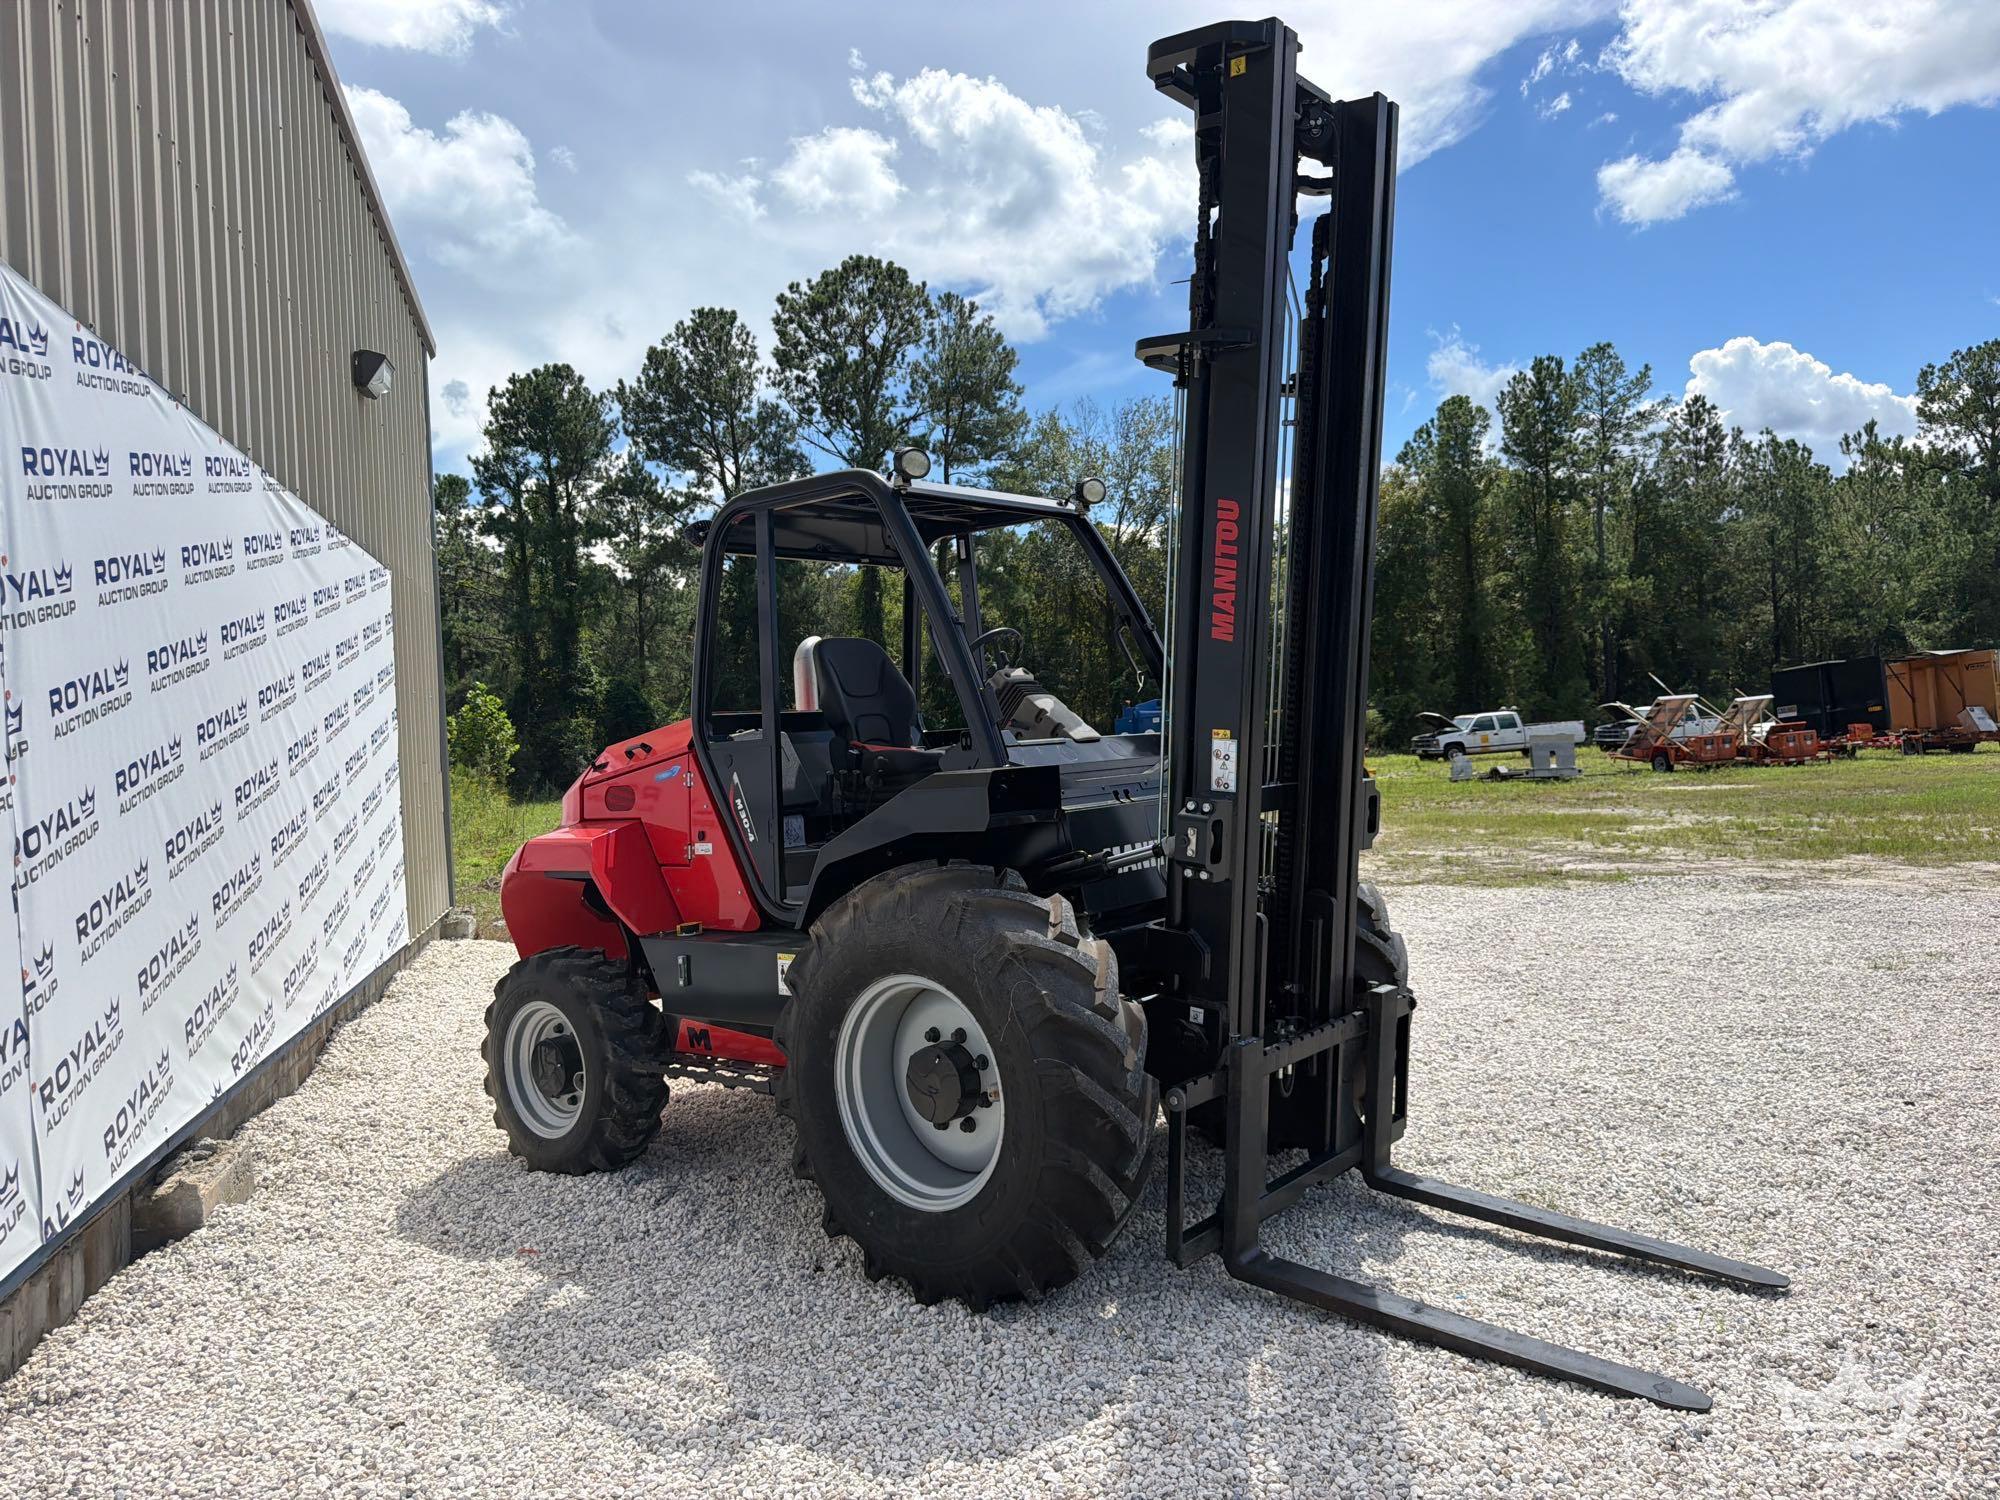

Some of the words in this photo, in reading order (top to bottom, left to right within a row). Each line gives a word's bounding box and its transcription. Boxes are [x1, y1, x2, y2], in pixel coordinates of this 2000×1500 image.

[9, 358, 51, 381] GROUP
[77, 372, 119, 393] AUCTION
[121, 380, 150, 397] GROUP
[21, 447, 94, 476] ROYAL
[130, 452, 181, 477] ROYAL
[205, 456, 242, 477] ROYAL
[27, 484, 77, 500] AUCTION
[78, 483, 112, 499] GROUP
[133, 483, 168, 497] AUCTION
[170, 483, 194, 495] GROUP
[208, 483, 234, 494] AUCTION
[234, 482, 252, 492] GROUP
[181, 542, 224, 568] ROYAL
[244, 533, 276, 556] ROYAL
[290, 527, 315, 546] ROYAL
[94, 553, 152, 586] ROYAL
[184, 569, 213, 586] AUCTION
[215, 564, 236, 578] GROUP
[247, 557, 268, 571] AUCTION
[267, 554, 284, 566] GROUP
[1211, 499, 1240, 642] MANITOU
[98, 586, 138, 607] AUCTION
[140, 579, 168, 597] GROUP
[313, 585, 335, 607] ROYAL
[344, 576, 362, 594] ROYAL
[2, 611, 36, 630] TION
[38, 600, 76, 623] GROUP
[274, 598, 301, 624] ROYAL
[220, 615, 257, 645] ROYAL
[223, 642, 249, 661] AUCTION
[249, 633, 267, 651] GROUP
[336, 637, 355, 659] ROYAL
[362, 623, 378, 641] ROYAL
[147, 637, 197, 675] ROYAL
[302, 655, 325, 680] ROYAL
[49, 668, 115, 718] ROYAL
[151, 669, 185, 694] AUCTION
[186, 658, 211, 678] GROUP
[258, 680, 289, 708] ROYAL
[260, 707, 282, 724] AUCTION
[281, 692, 297, 710] GROUP
[353, 685, 369, 707] ROYAL
[54, 705, 99, 740] AUCTION
[100, 691, 132, 716] GROUP
[196, 706, 239, 746] ROYAL
[324, 704, 345, 733] ROYAL
[199, 735, 229, 764] AUCTION
[229, 722, 250, 744] GROUP
[288, 732, 314, 765] ROYAL
[115, 746, 170, 797] ROYAL
[345, 750, 363, 776] ROYAL
[119, 782, 156, 817] AUCTION
[157, 763, 184, 790] GROUP
[235, 767, 269, 807] ROYAL
[238, 793, 262, 822] AUCTION
[262, 780, 281, 802] GROUP
[313, 778, 335, 811] ROYAL
[361, 787, 378, 814] ROYAL
[165, 811, 212, 864] ROYAL
[169, 844, 200, 882] AUCTION
[201, 826, 225, 853] GROUP
[271, 815, 301, 856] ROYAL
[273, 843, 295, 870] AUCTION
[295, 827, 309, 848] GROUP
[333, 820, 353, 854] ROYAL
[17, 846, 63, 890] UCTION
[64, 820, 100, 857] GROUP
[353, 857, 371, 889] ROYAL
[212, 864, 252, 915] ROYAL
[299, 861, 323, 901] ROYAL
[76, 875, 135, 944] ROYAL
[215, 896, 242, 932] AUCTION
[242, 875, 263, 903] GROUP
[323, 897, 347, 938] ROYAL
[370, 890, 386, 921] ROYAL
[81, 916, 122, 966] AUCTION
[122, 888, 152, 924] GROUP
[248, 911, 283, 962] ROYAL
[138, 929, 187, 996] ROYAL
[251, 942, 275, 978] AUCTION
[274, 919, 292, 948] GROUP
[343, 929, 362, 972] ROYAL
[142, 968, 176, 1016] AUCTION
[176, 939, 202, 974] GROUP
[283, 949, 313, 999] ROYAL
[26, 978, 58, 1016] ROUP
[185, 979, 227, 1044] ROYAL
[188, 1013, 217, 1061] AUCTION
[217, 986, 240, 1020] GROUP
[231, 1014, 266, 1077] ROYAL
[40, 1020, 106, 1114] ROYAL
[46, 1068, 91, 1138] AUCTION
[92, 1028, 124, 1075] GROUP
[104, 1070, 158, 1158] ROYAL
[110, 1115, 148, 1178] AUCTION
[147, 1075, 174, 1119] GROUP
[0, 1199, 26, 1245] OUP
